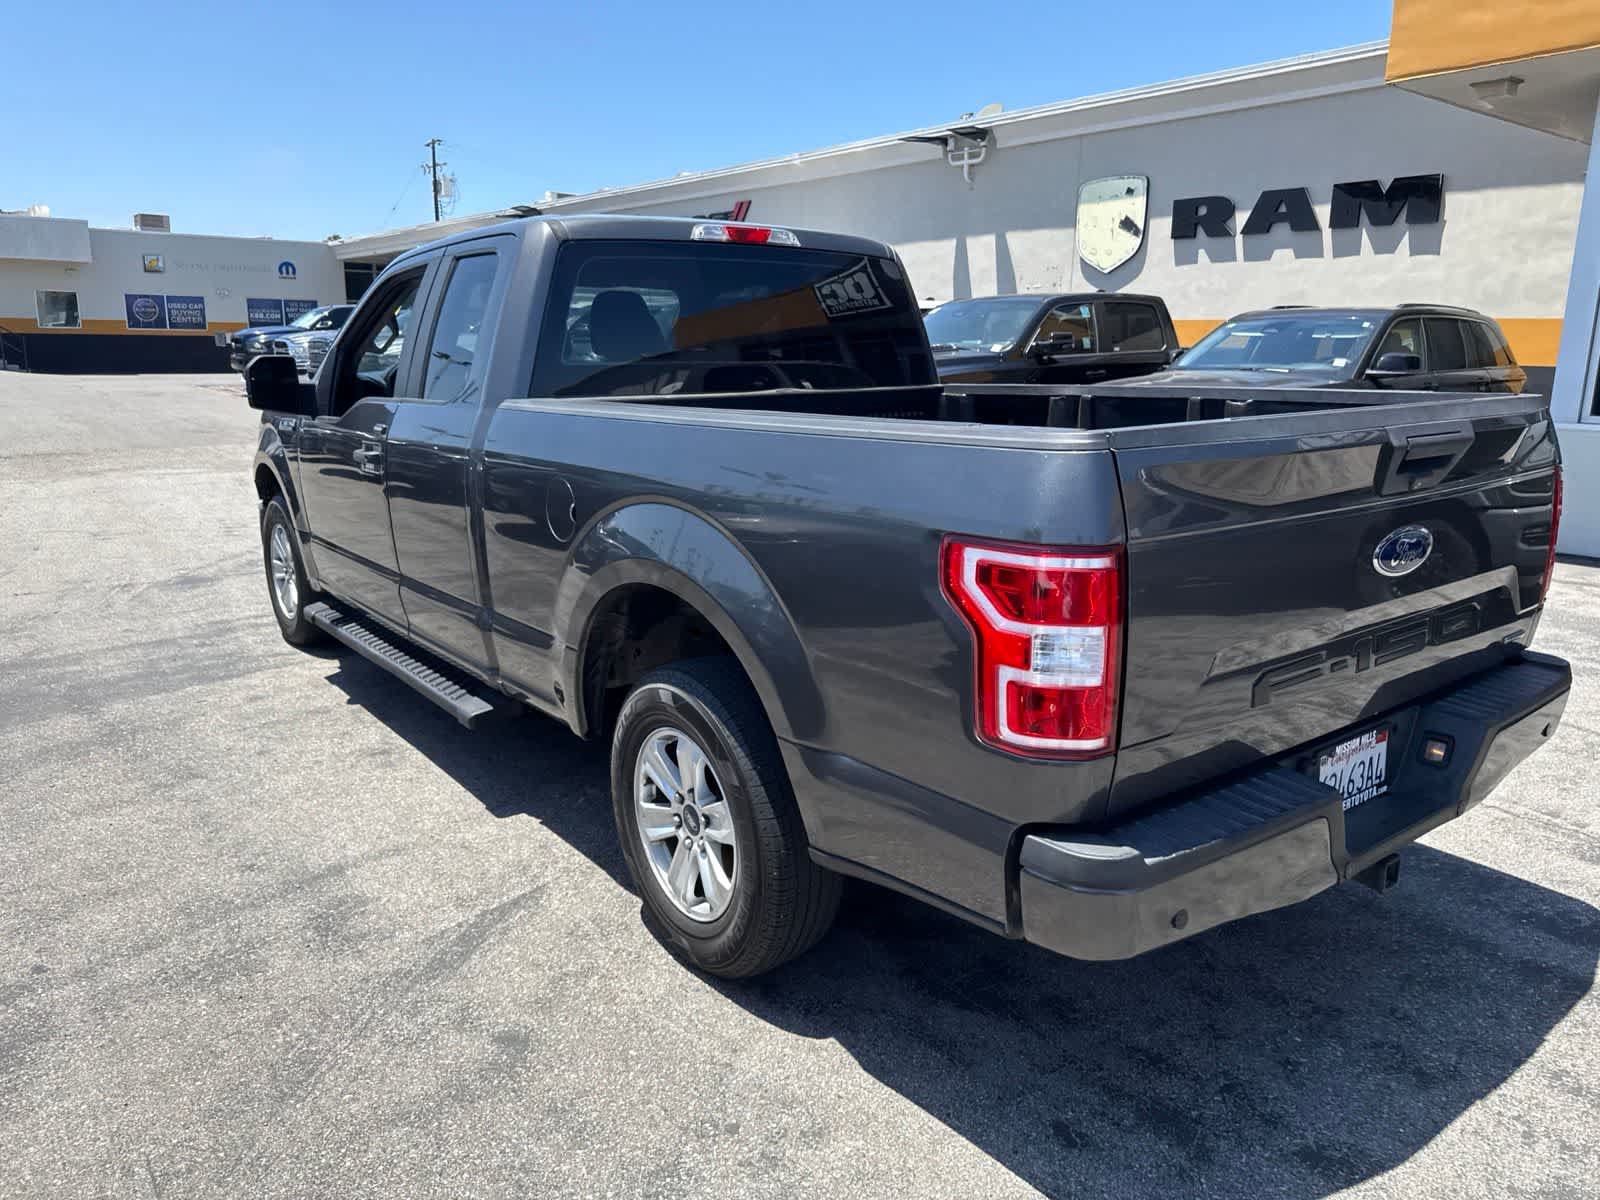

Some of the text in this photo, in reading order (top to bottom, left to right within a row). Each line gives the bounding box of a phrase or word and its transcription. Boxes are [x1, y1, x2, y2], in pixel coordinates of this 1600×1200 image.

[1171, 173, 1444, 239] RAM
[170, 316, 203, 324] CENTER
[171, 309, 201, 317] BUYING
[1390, 538, 1424, 567] Ford
[1251, 602, 1481, 709] F-150
[1335, 729, 1377, 753] MISSION HILLS
[1322, 752, 1383, 797] 463A4
[1342, 785, 1387, 811] ERTOYOTA.com
